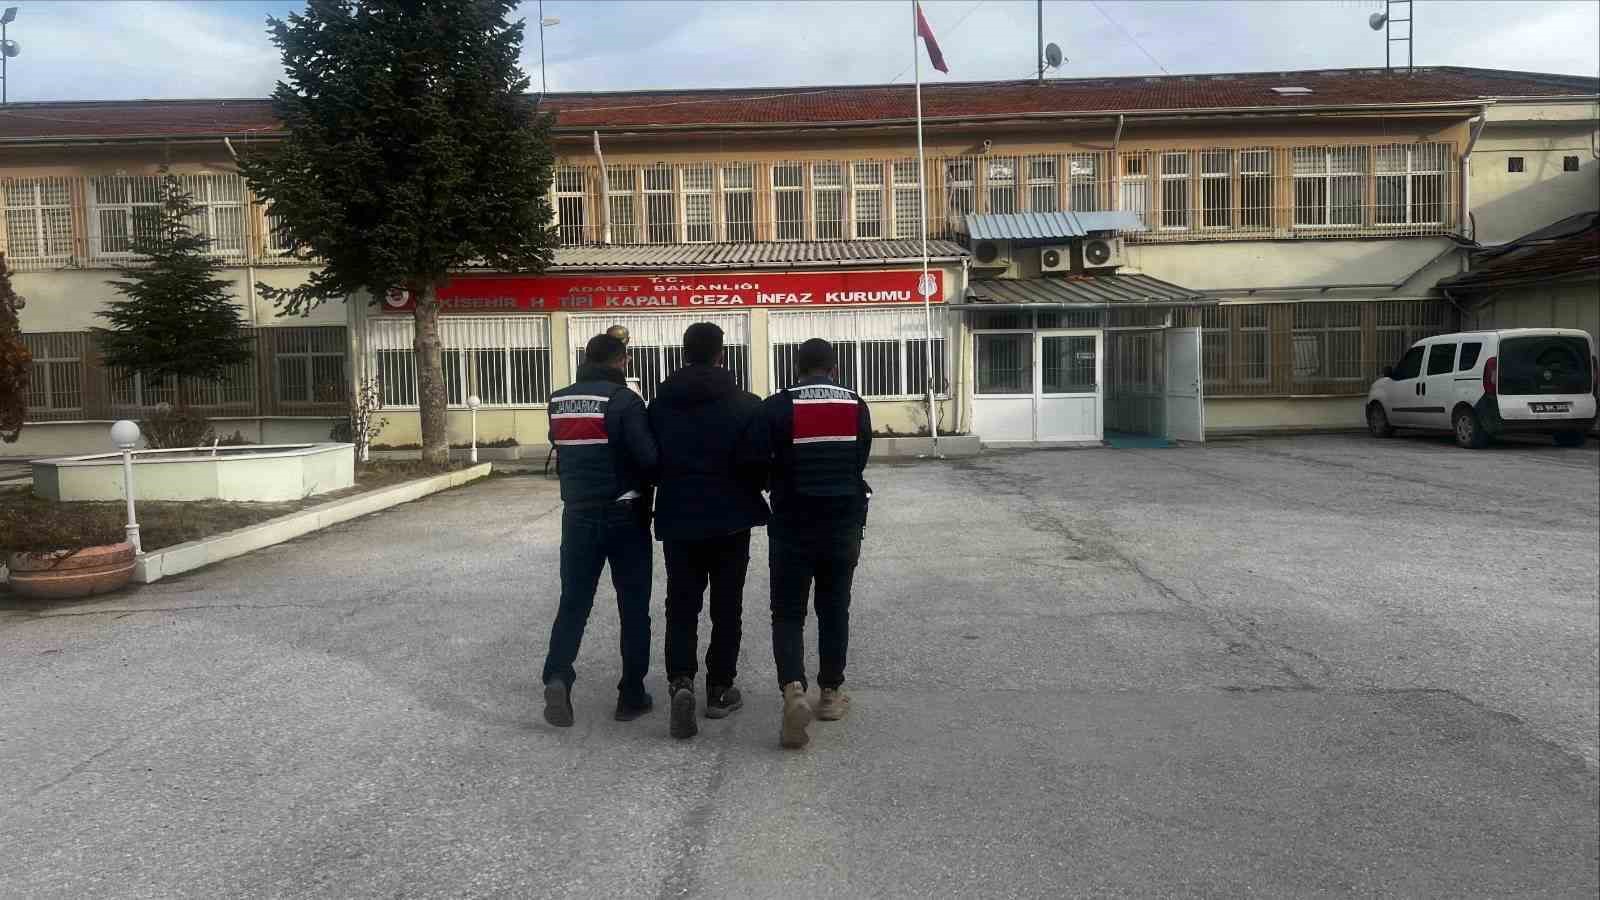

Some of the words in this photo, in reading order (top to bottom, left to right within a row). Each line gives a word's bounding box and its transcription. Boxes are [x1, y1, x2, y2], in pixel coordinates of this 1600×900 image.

[648, 276, 684, 285] T.C.
[568, 285, 641, 294] ADALET
[654, 282, 760, 293] BAKANLIĞI
[529, 296, 545, 308] H
[559, 294, 593, 308] TİPİ
[605, 295, 679, 307] KAPALI
[689, 294, 744, 305] CEZA
[756, 291, 813, 304] İNFAZ
[825, 290, 912, 303] KURUMU
[798, 387, 852, 400] JANDARMA
[556, 400, 601, 413] JANDARMA
